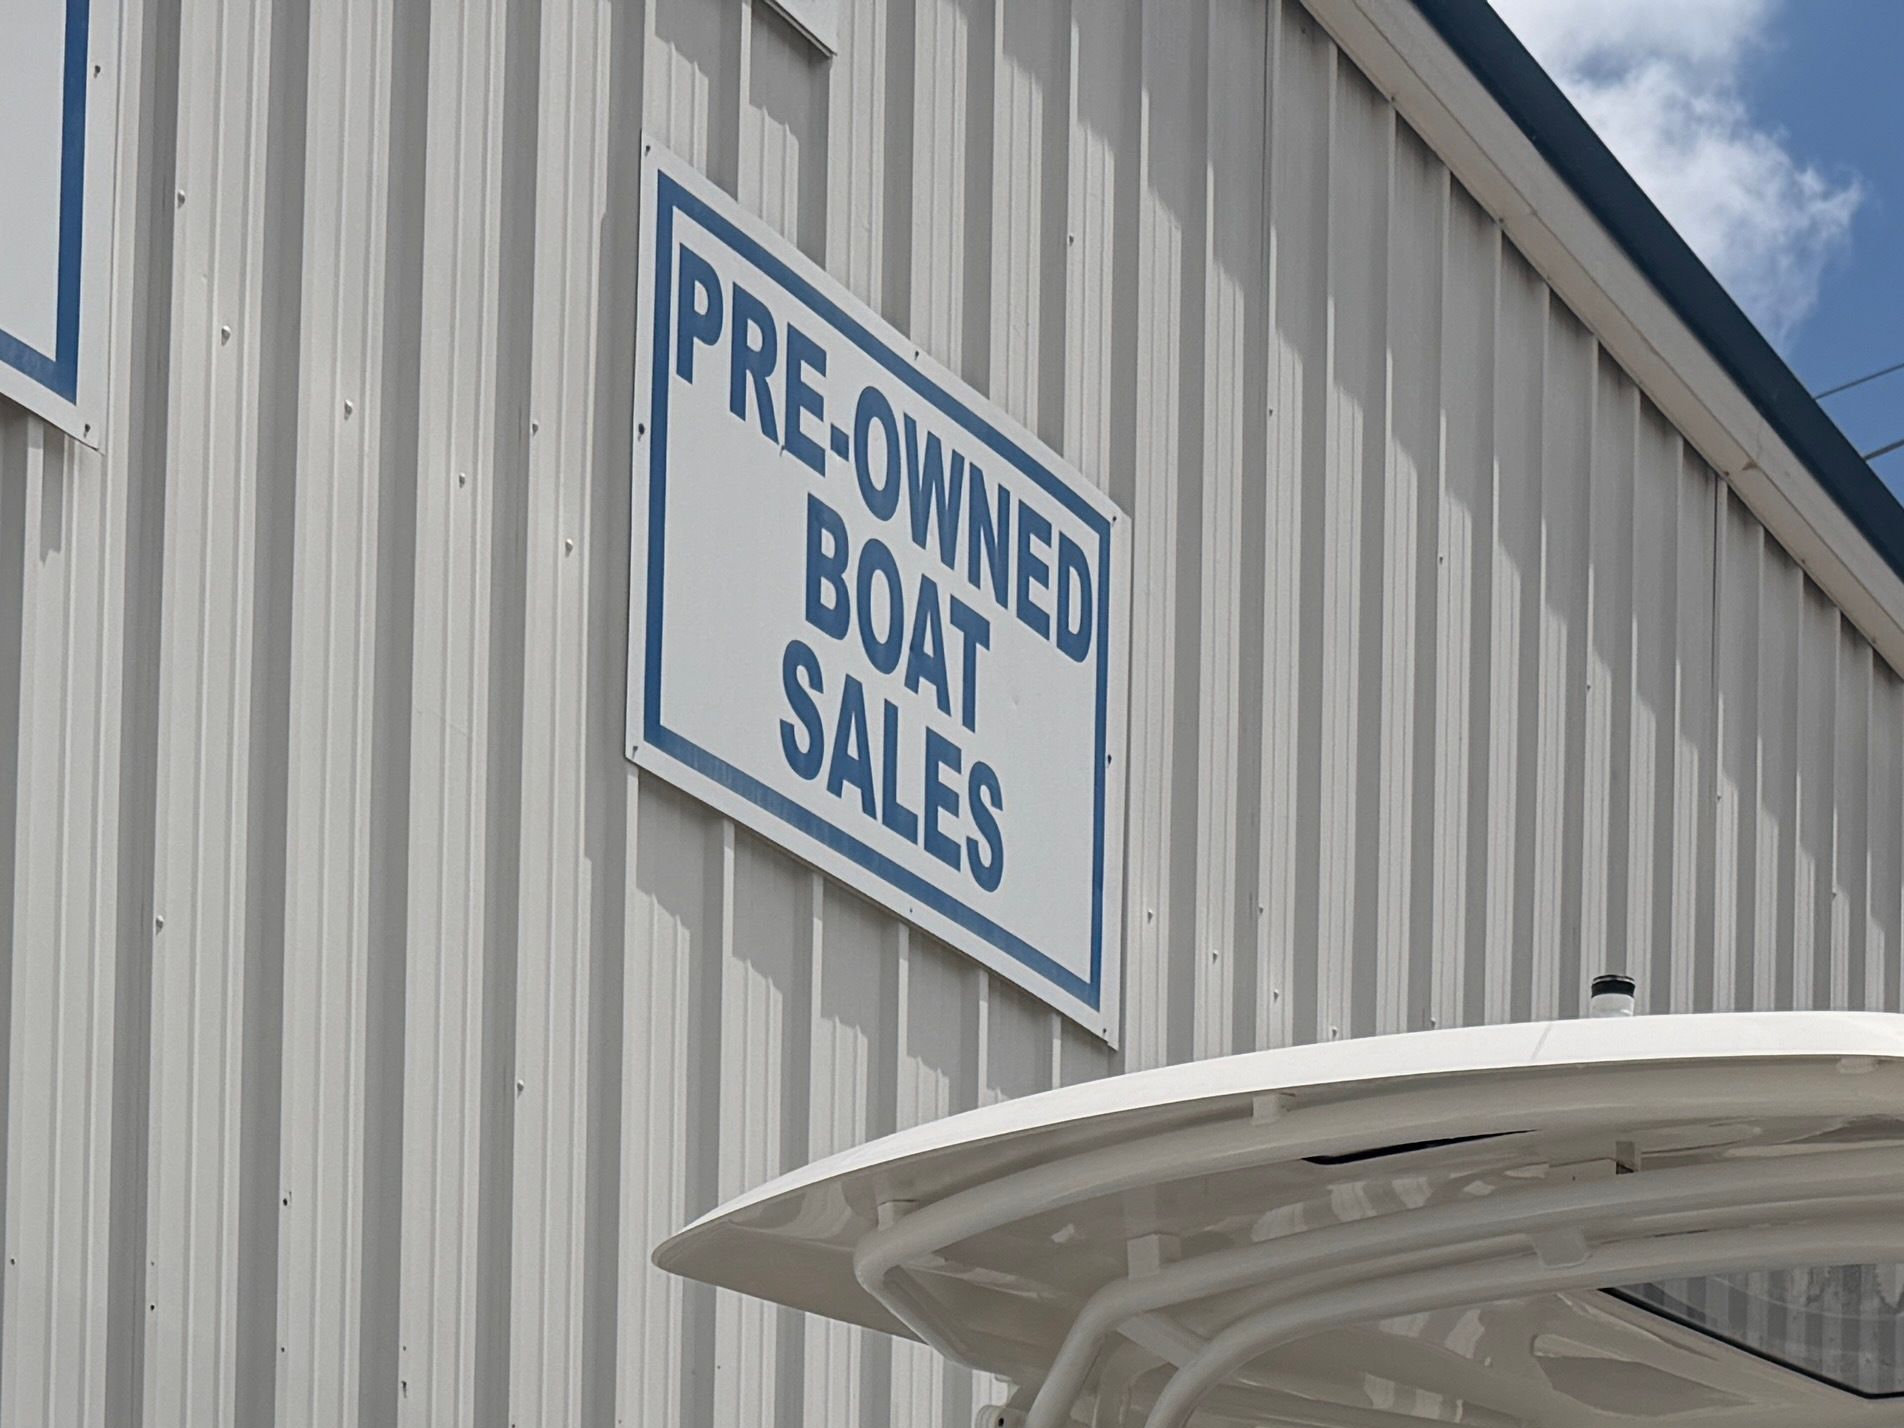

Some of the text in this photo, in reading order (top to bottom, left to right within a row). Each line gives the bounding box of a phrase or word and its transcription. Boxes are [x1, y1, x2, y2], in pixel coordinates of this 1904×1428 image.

[675, 241, 1094, 663] PRE-OWNED
[805, 492, 991, 733] BOAT
[780, 639, 1005, 893] SALES
